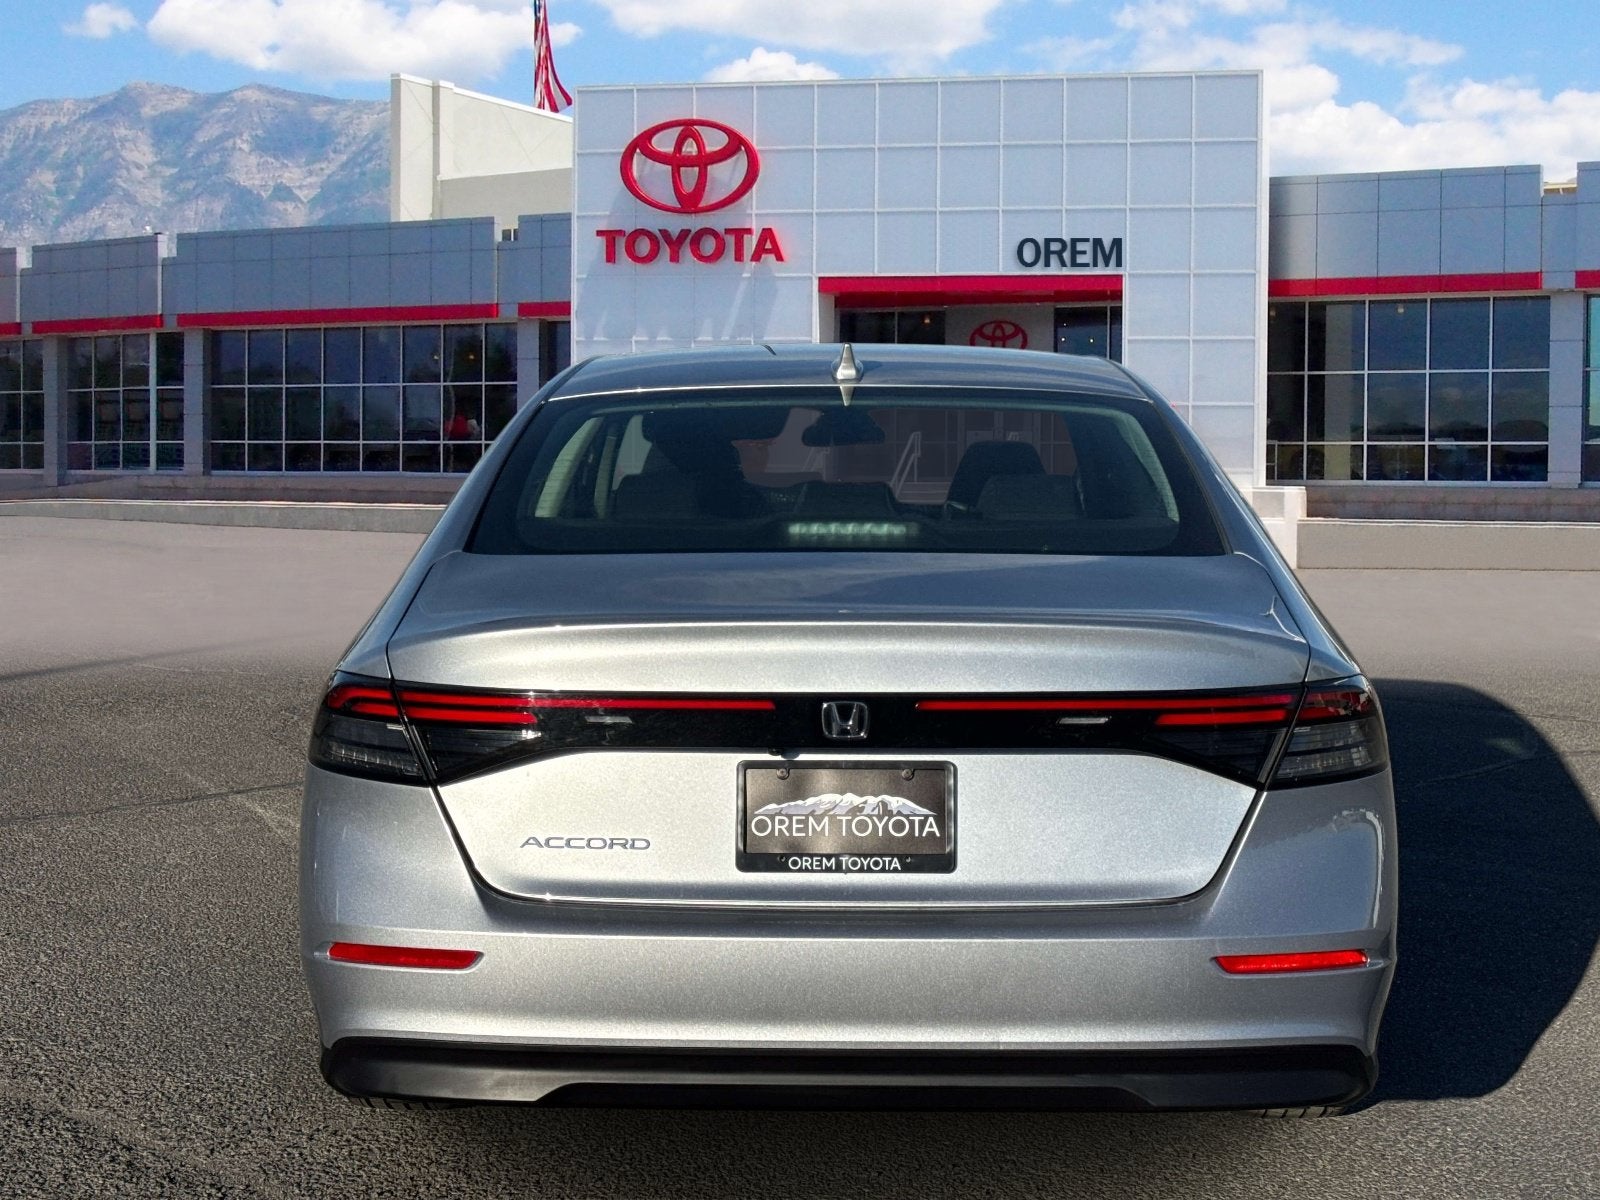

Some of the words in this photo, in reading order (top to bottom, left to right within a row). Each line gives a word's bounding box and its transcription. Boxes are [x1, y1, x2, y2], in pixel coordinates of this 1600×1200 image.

[596, 227, 785, 264] TOYOTA
[1016, 236, 1123, 268] OREM
[751, 815, 829, 837] OREM
[837, 815, 941, 838] TOYOTA
[519, 836, 651, 850] ACCORD
[788, 856, 835, 871] OREM
[839, 856, 901, 871] TOYOTA
